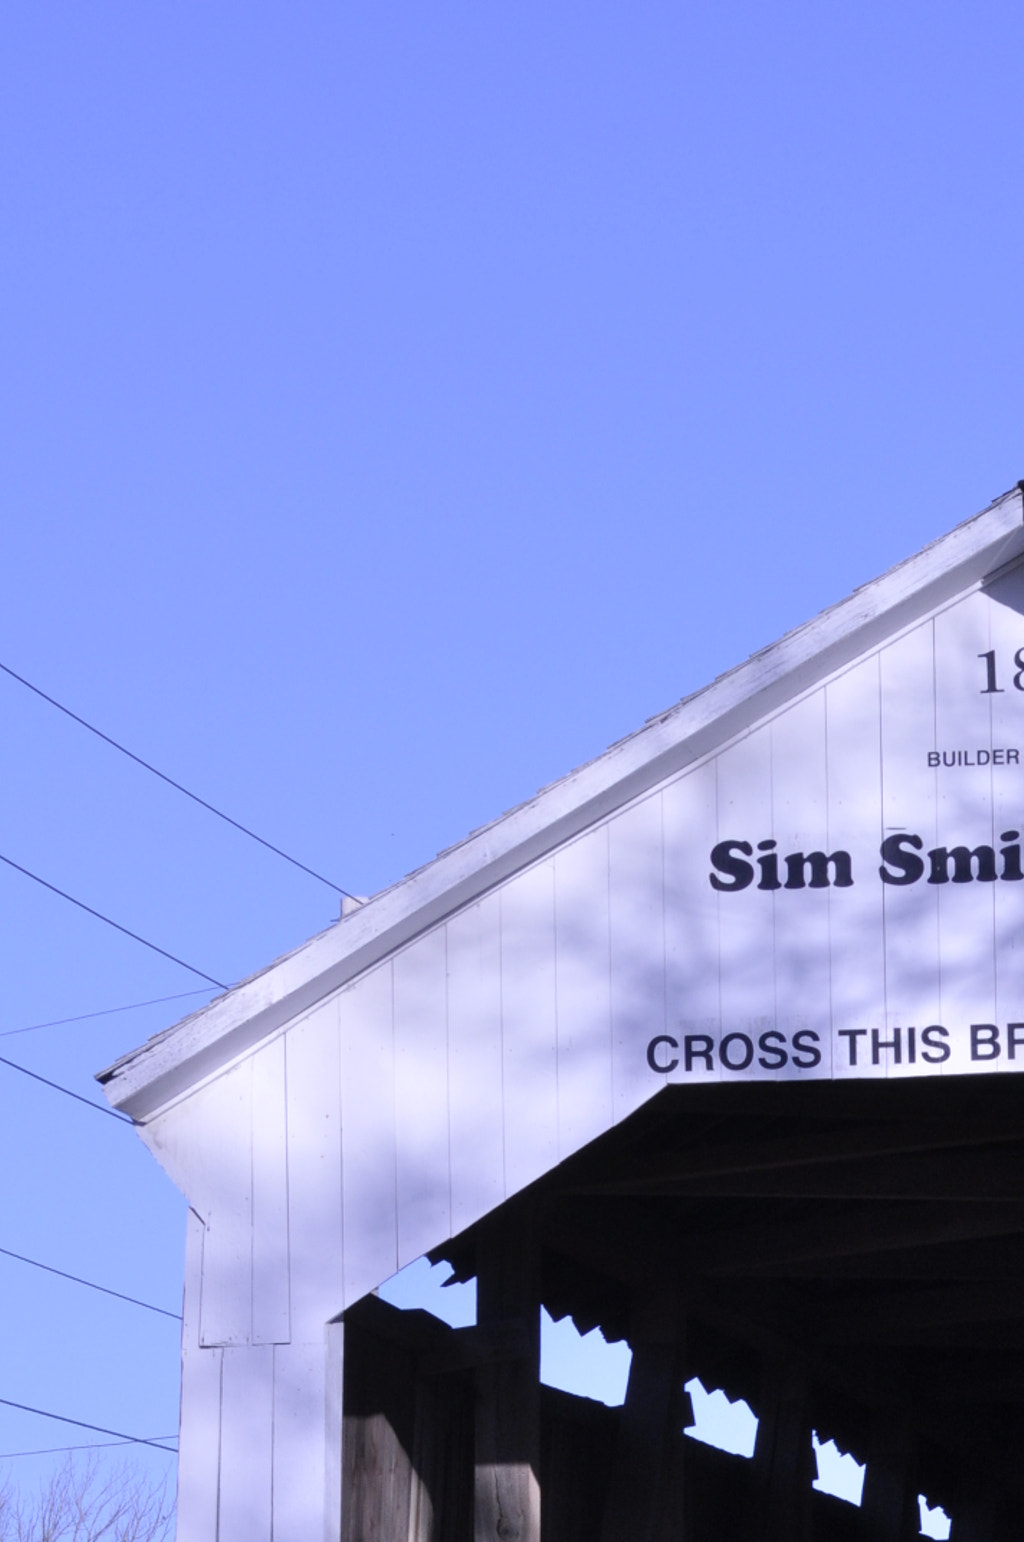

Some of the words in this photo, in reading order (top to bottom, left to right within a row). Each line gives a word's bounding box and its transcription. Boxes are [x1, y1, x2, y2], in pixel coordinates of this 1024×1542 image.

[927, 750, 1020, 767] BUILDER
[709, 840, 853, 891] Sim
[646, 1030, 821, 1073] CROSS
[838, 1025, 951, 1066] THIS
